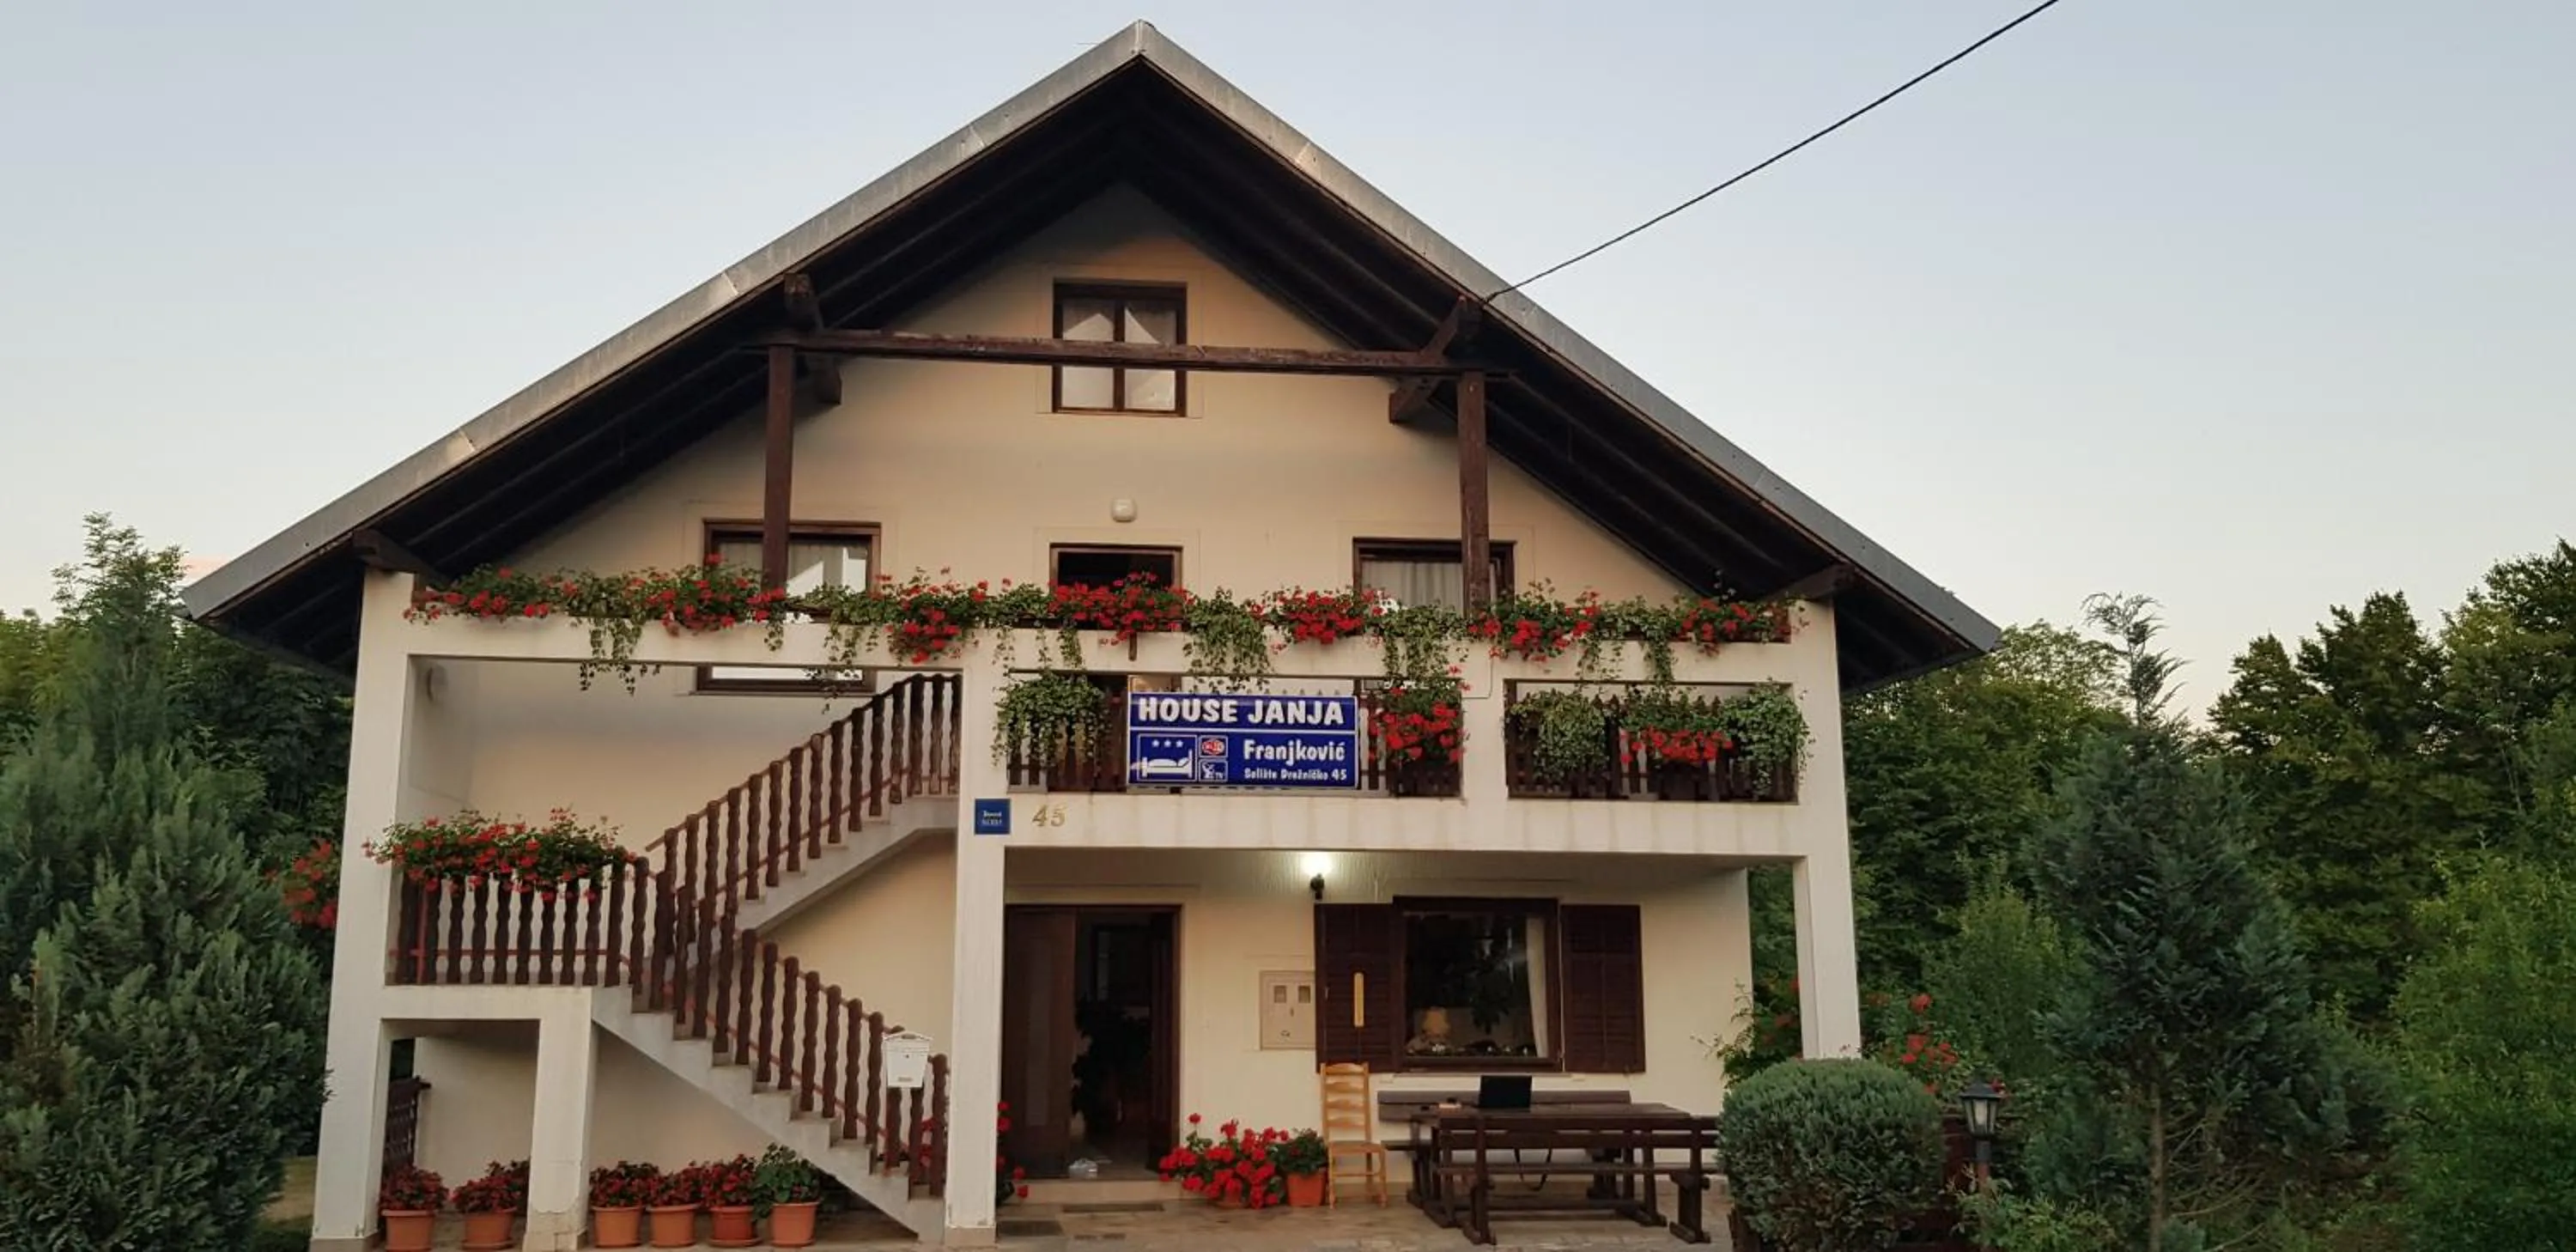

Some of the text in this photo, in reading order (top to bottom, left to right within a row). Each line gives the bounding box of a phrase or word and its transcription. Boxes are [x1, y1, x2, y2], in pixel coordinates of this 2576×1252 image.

[1139, 697, 1345, 725] HOUSE JANJA
[1243, 738, 1346, 766] Franjković
[1332, 769, 1347, 781] 45
[1031, 804, 1067, 827] 45
